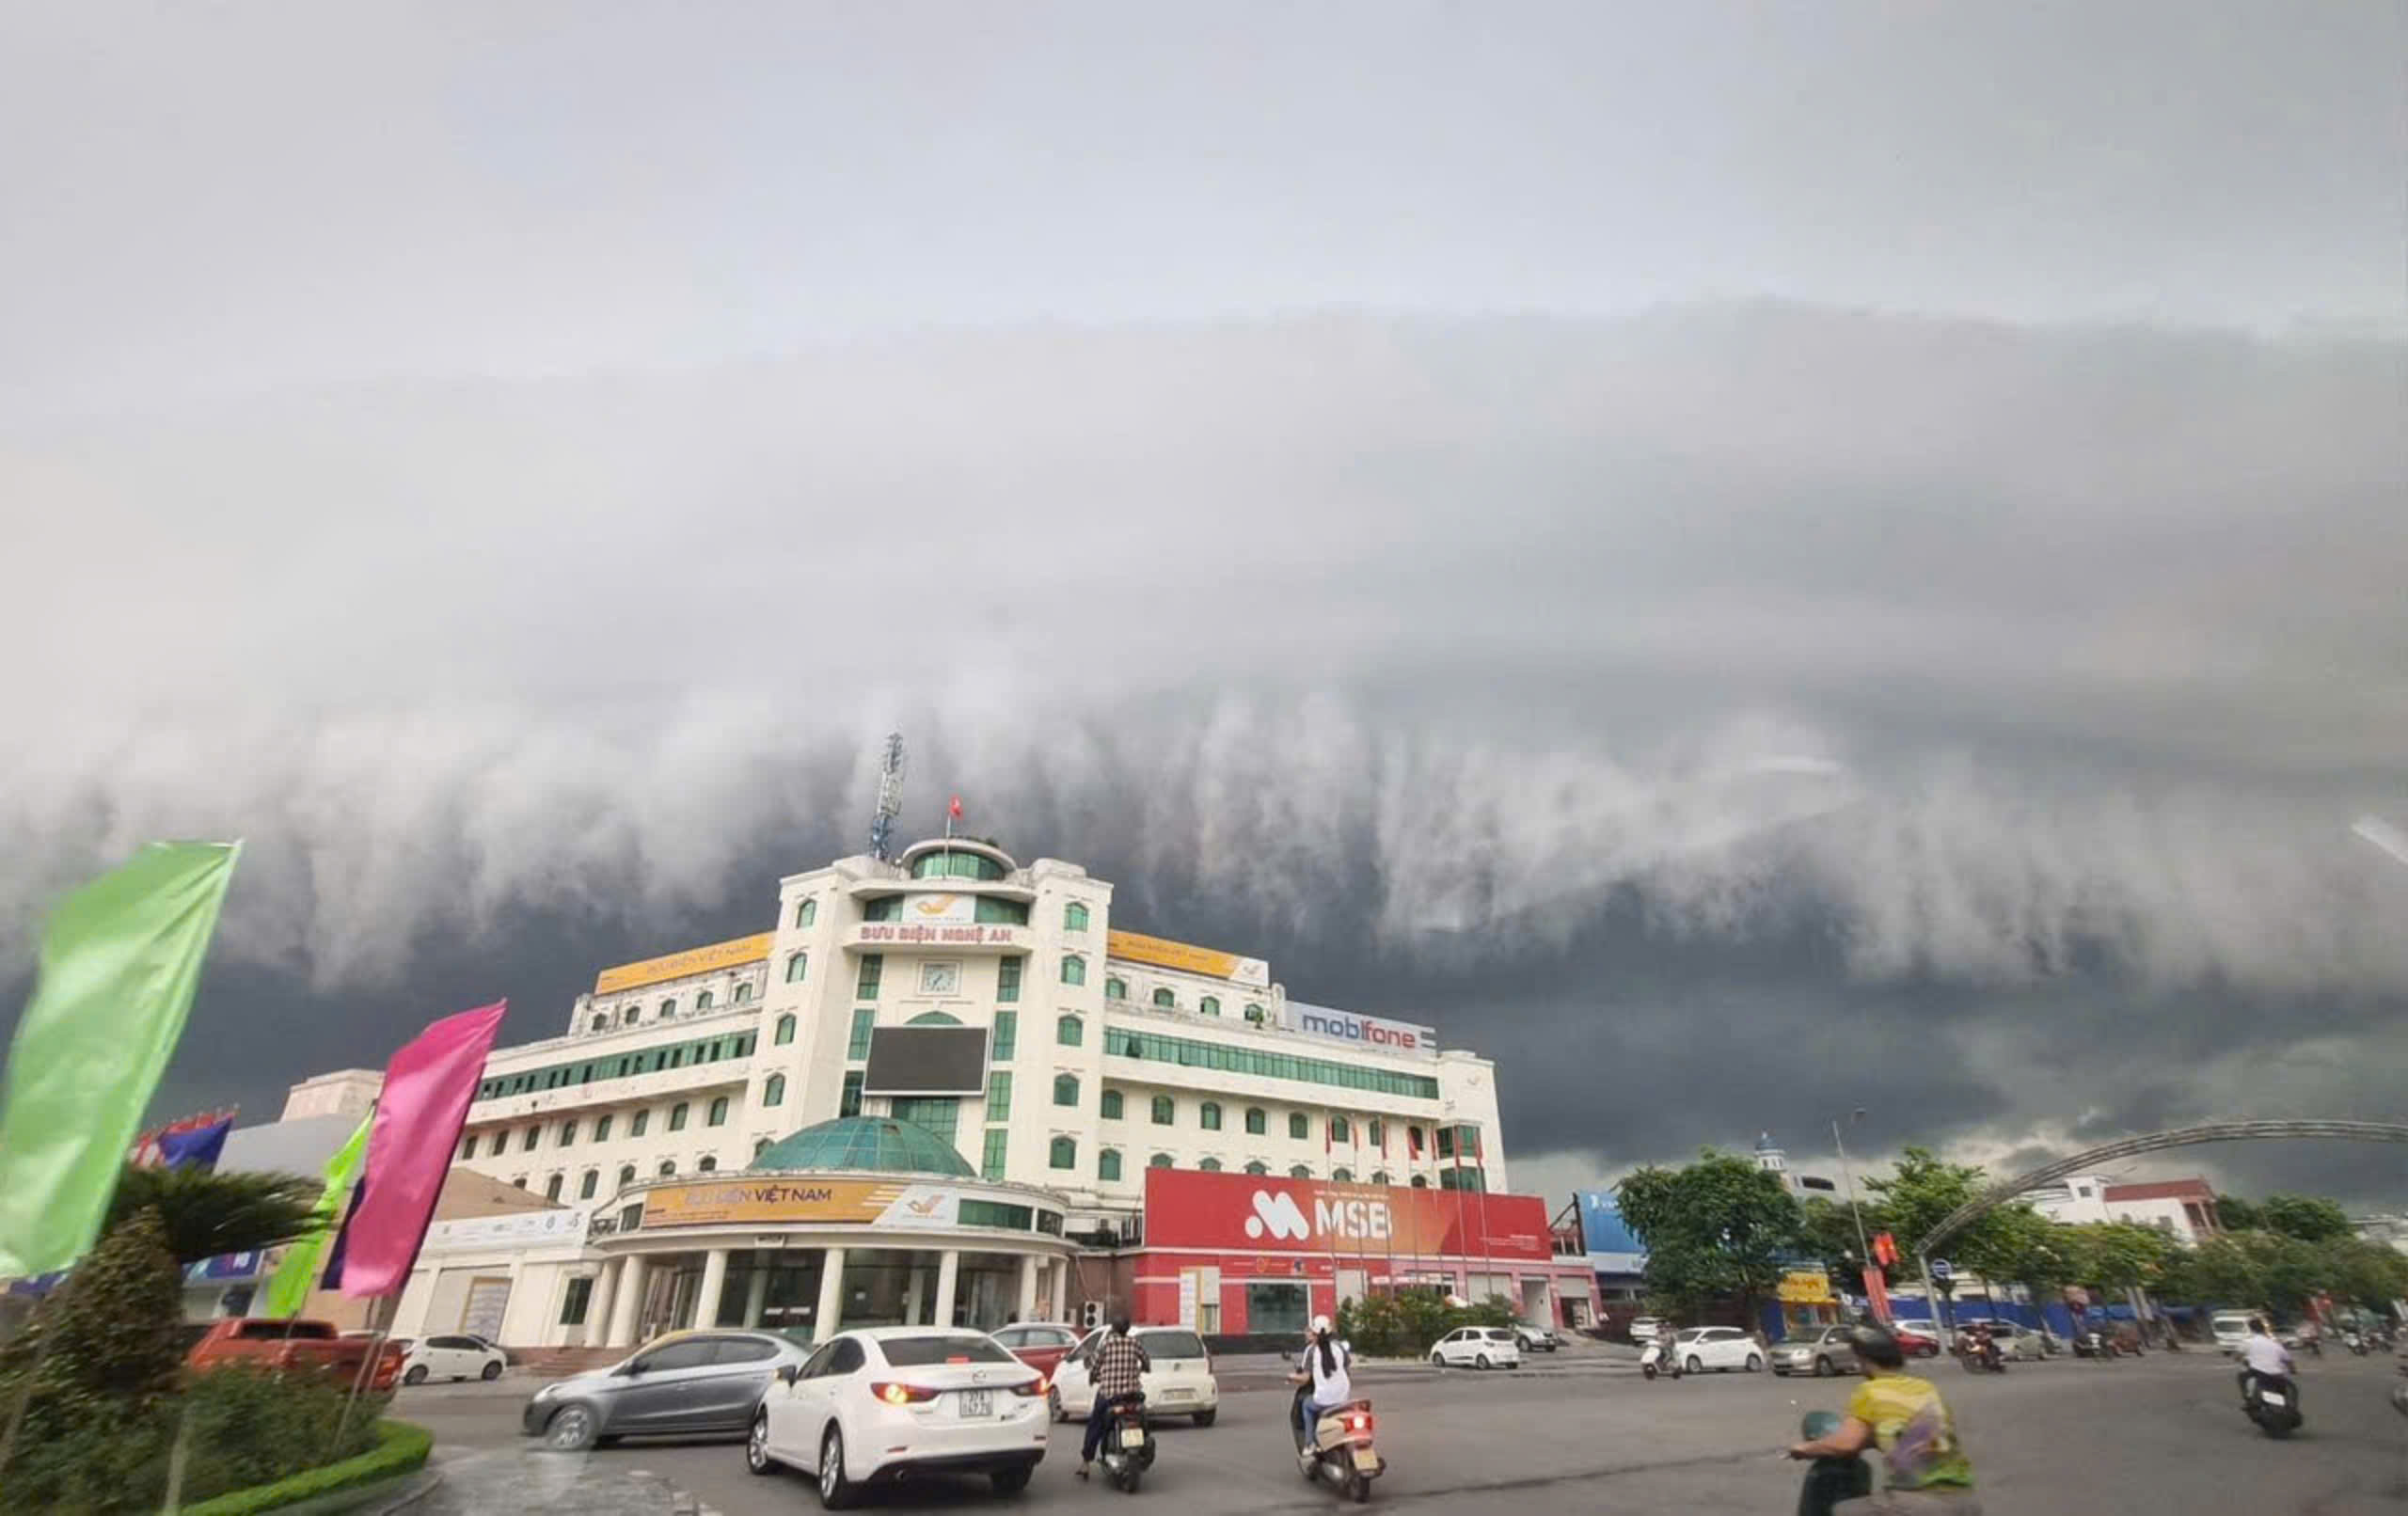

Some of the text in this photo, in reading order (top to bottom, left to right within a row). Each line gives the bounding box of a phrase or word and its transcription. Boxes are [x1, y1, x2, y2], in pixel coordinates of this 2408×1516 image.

[1303, 1015, 1416, 1049] mobifone
[754, 1184, 789, 1204] VIỆT
[791, 1189, 832, 1202] NAM
[1314, 1198, 1392, 1239] MSB
